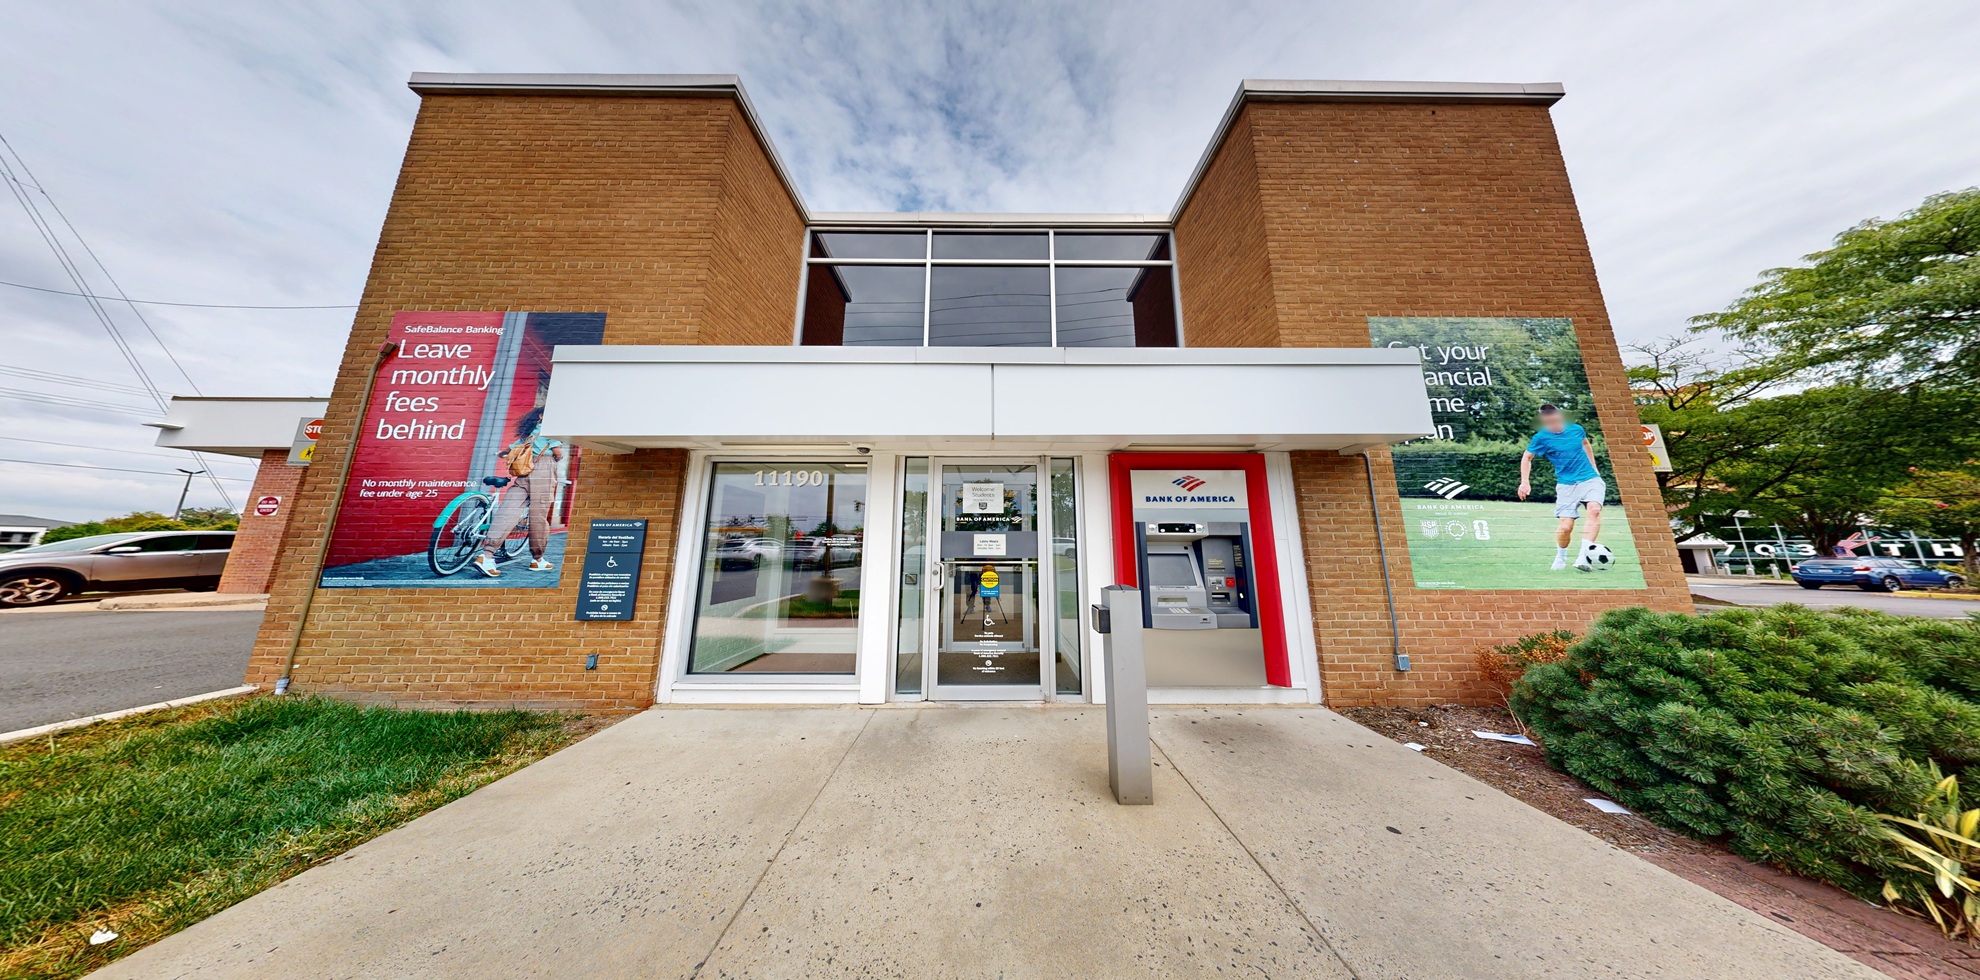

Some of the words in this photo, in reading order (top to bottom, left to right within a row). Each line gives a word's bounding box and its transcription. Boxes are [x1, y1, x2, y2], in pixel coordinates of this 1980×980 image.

[404, 325, 463, 334] SafeBalance
[465, 325, 503, 336] Banking
[397, 339, 472, 359] Leave
[1437, 345, 1489, 365] your
[390, 365, 496, 391] monthly
[1424, 366, 1492, 385] ancial
[385, 391, 439, 412] fees
[1428, 397, 1465, 413] me
[376, 418, 466, 440] behind
[362, 479, 377, 488] No
[378, 479, 417, 490] monthly
[418, 480, 477, 488] maintenance
[754, 470, 823, 487] 11190
[359, 489, 376, 498] fee
[377, 490, 404, 498] under
[405, 491, 424, 500] age
[425, 489, 439, 498] 25
